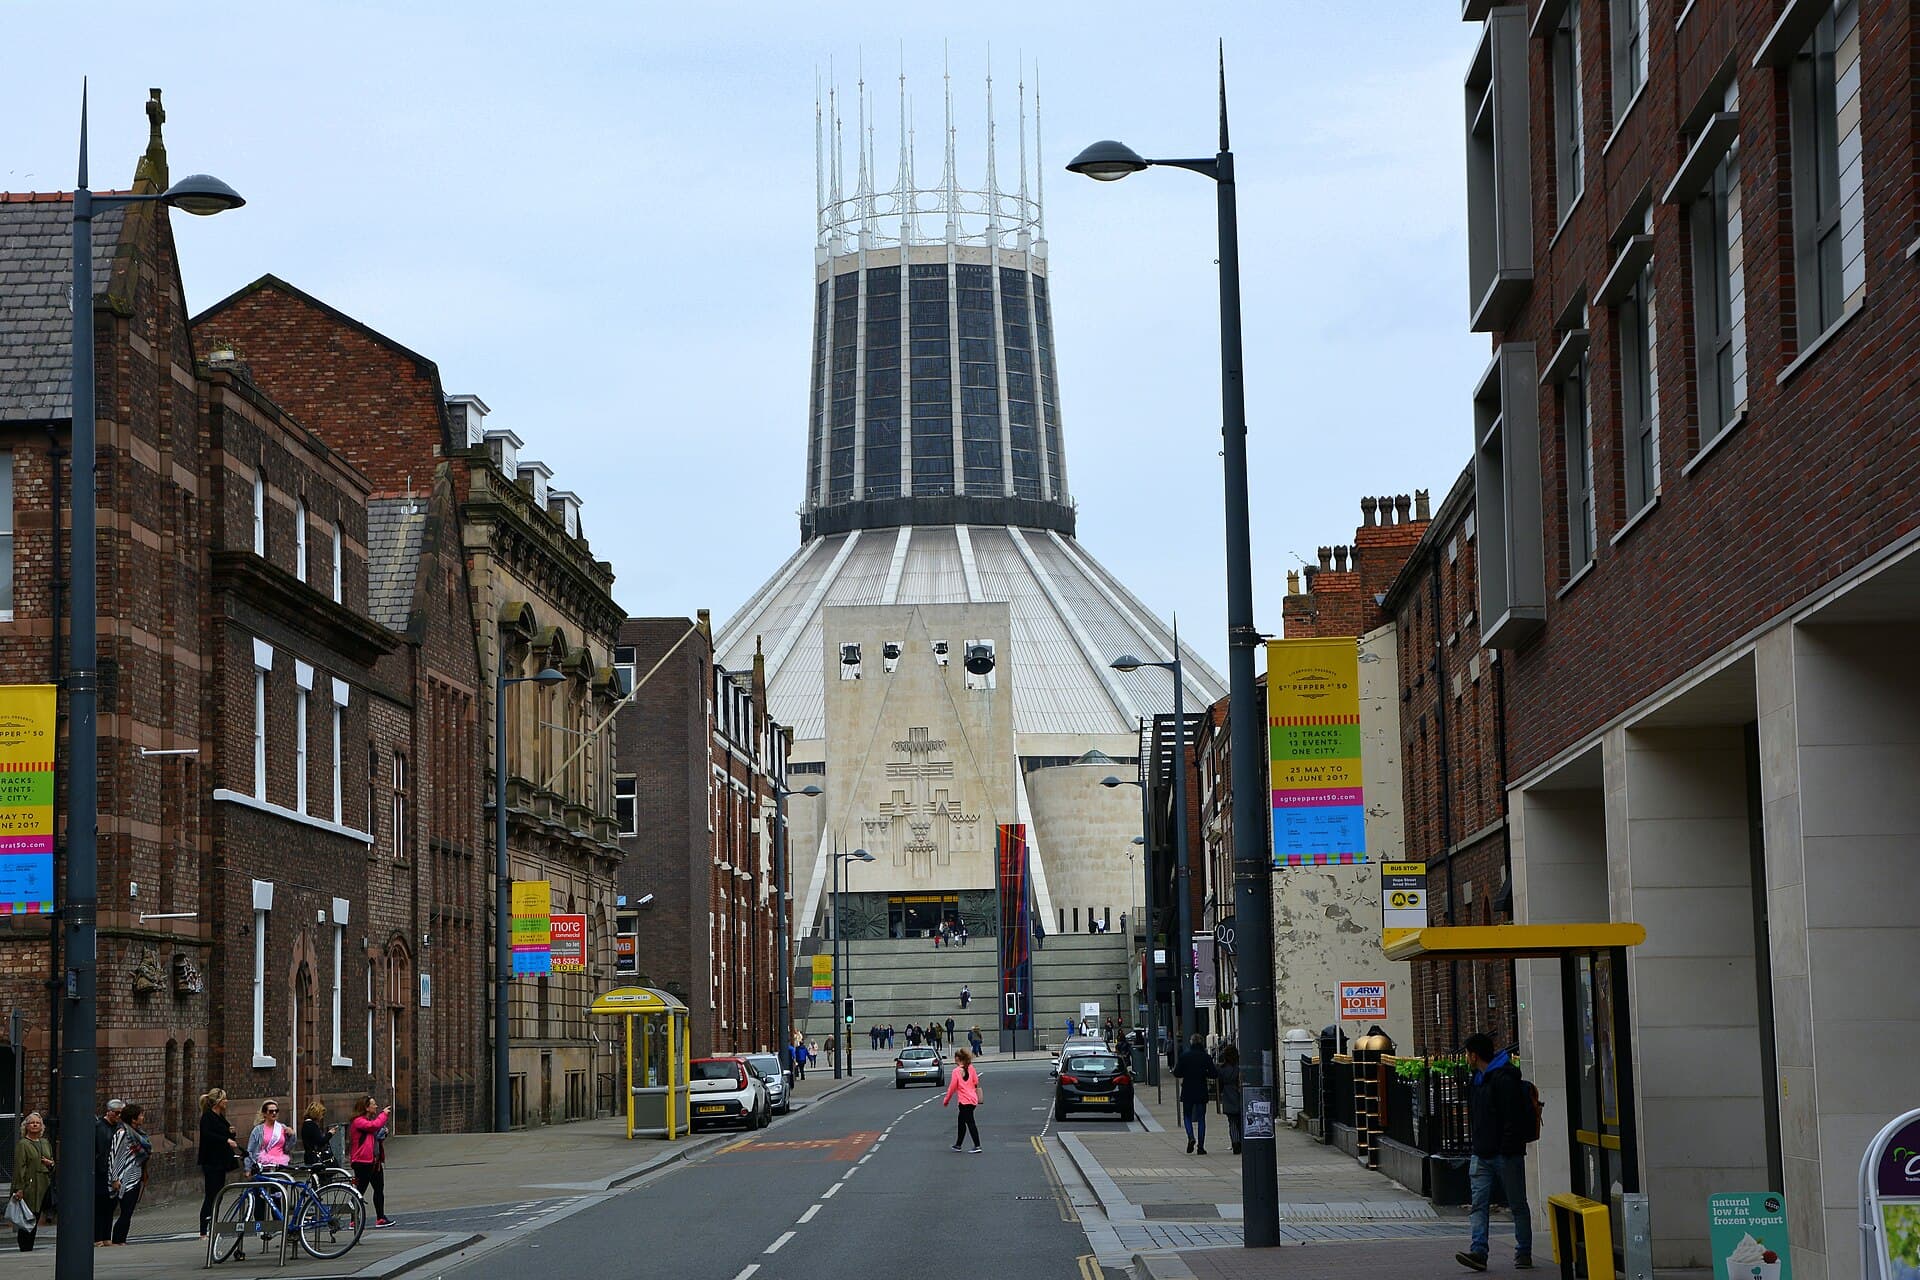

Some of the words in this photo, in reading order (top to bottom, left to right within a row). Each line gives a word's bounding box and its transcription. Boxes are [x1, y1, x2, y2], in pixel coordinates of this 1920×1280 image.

[1292, 683, 1325, 691] PEPPER
[1314, 747, 1340, 755] CITY.
[1279, 794, 1356, 803] sgtpepperat50.com
[17, 821, 39, 829] 2017
[550, 921, 581, 932] more
[1355, 986, 1380, 994] ARW
[1345, 998, 1362, 1008] TO
[1364, 998, 1382, 1008] LET
[1712, 1197, 1750, 1207] natural
[1713, 1207, 1731, 1216] low
[1734, 1206, 1750, 1216] fat
[1714, 1216, 1746, 1225] frozen
[1748, 1216, 1784, 1226] yogurt
